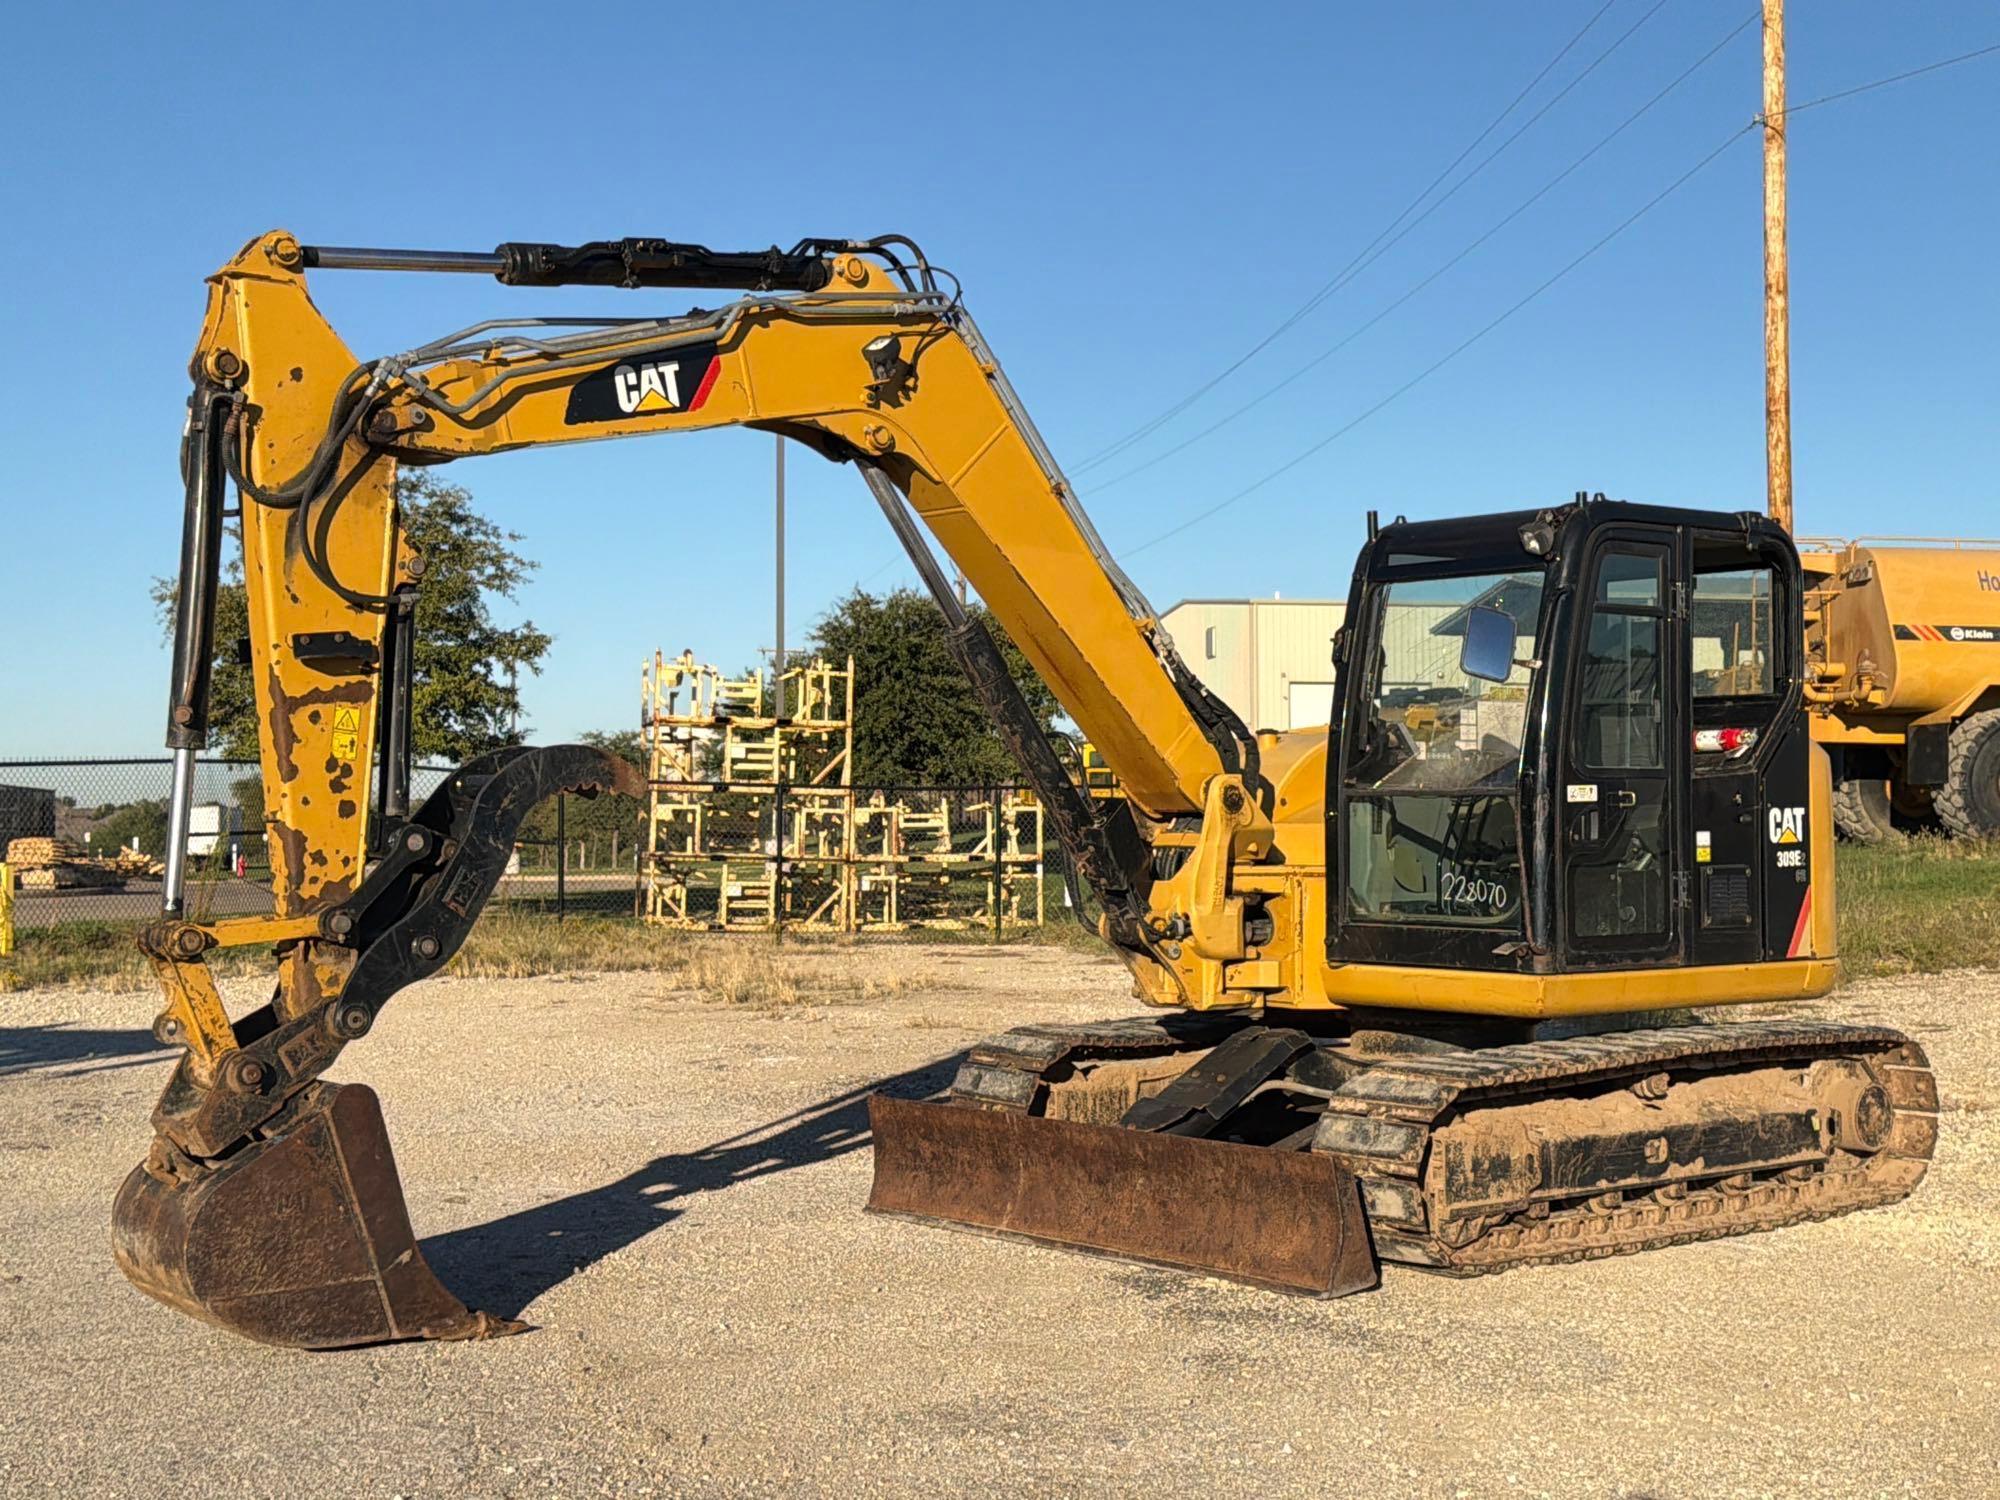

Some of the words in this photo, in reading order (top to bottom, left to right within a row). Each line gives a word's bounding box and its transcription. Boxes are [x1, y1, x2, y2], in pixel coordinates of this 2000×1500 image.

[614, 361, 680, 413] CAT
[1965, 629, 1994, 639] Klein
[1769, 807, 1805, 843] CAT
[1441, 872, 1507, 908] 228070
